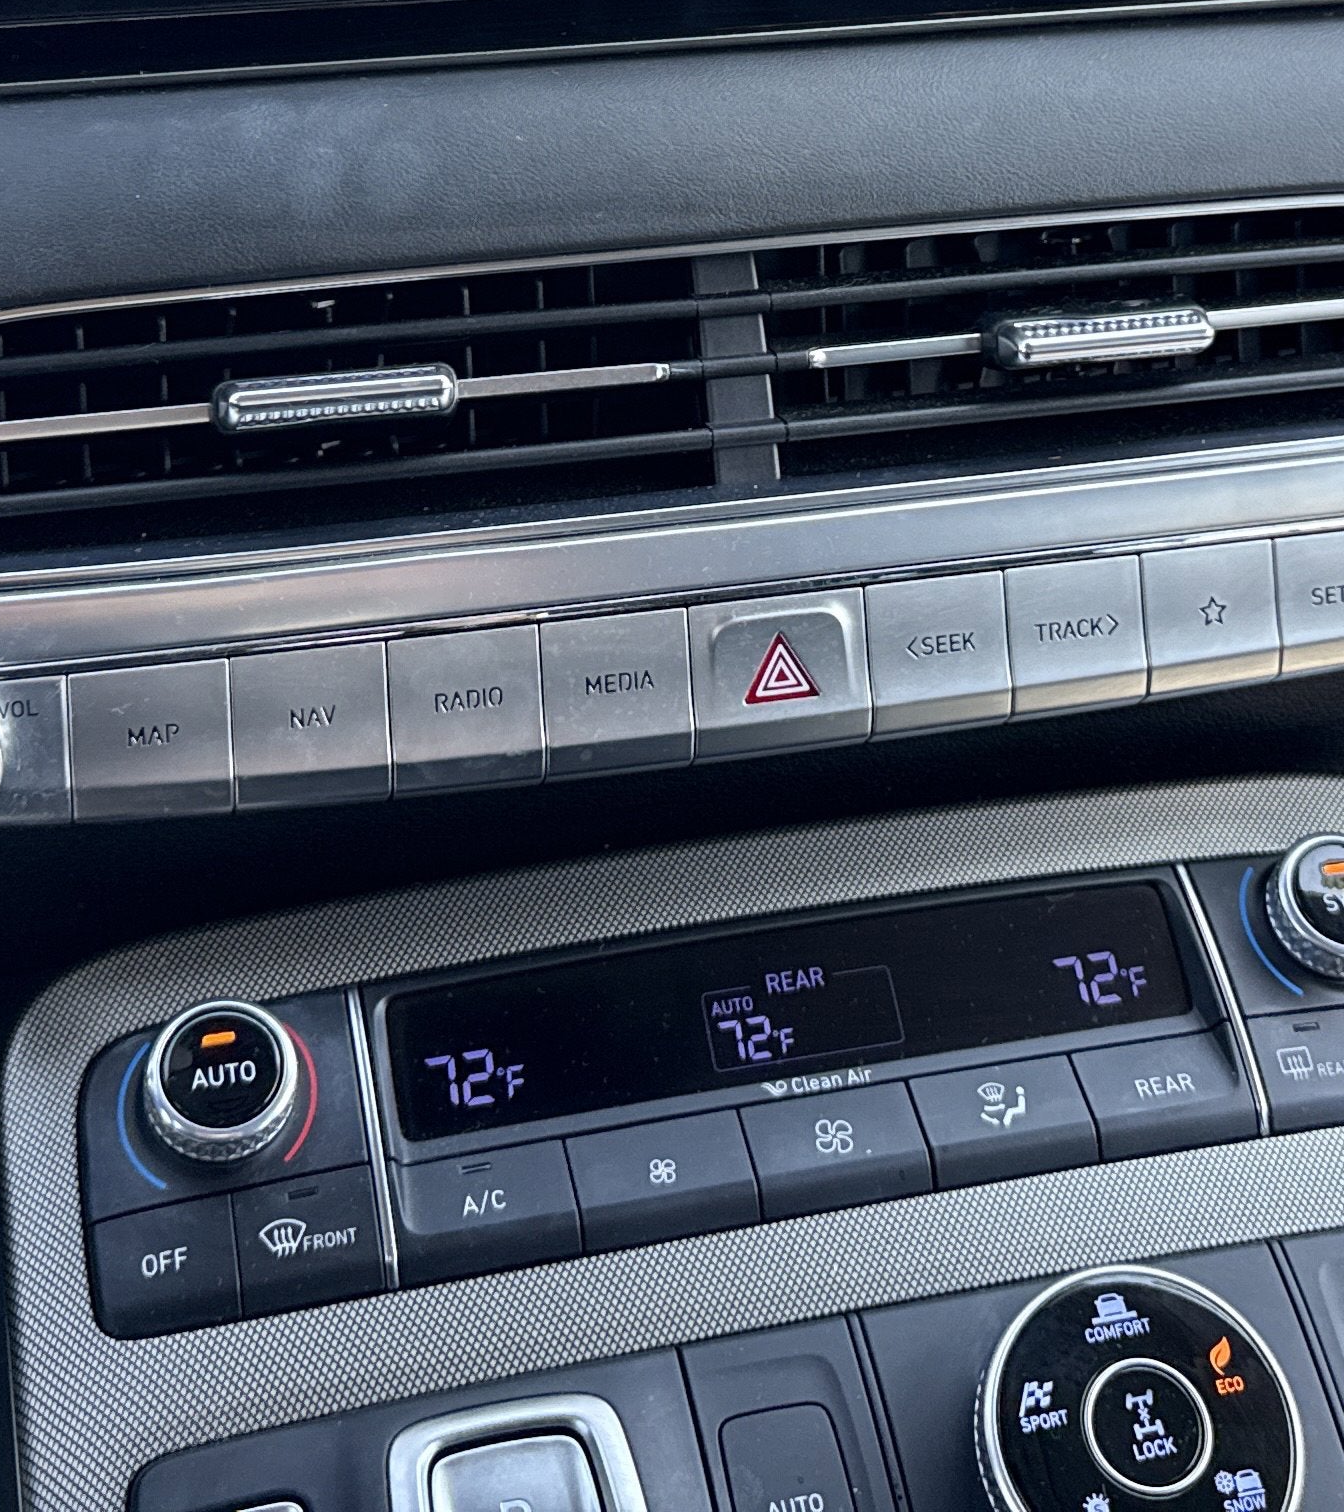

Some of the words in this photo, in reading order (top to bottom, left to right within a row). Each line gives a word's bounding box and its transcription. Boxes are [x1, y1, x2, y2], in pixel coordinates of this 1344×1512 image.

[585, 669, 655, 696] MEDIA
[434, 686, 503, 714] RADIO
[289, 704, 336, 730] NAV
[128, 724, 180, 747] MAP
[765, 967, 825, 993] REAR
[711, 996, 753, 1017] AUTO
[191, 1060, 257, 1091] AUTO
[791, 1073, 843, 1094] Clean
[846, 1067, 872, 1086] Air
[1134, 1073, 1195, 1099] REAR
[462, 1190, 507, 1217] A/C
[303, 1226, 357, 1251] FRONT
[141, 1246, 188, 1279] OFF
[1084, 1317, 1151, 1344] COMFORT
[1215, 1376, 1244, 1394] ECO
[1019, 1408, 1068, 1433] SPORT
[1132, 1436, 1178, 1462] LOCK
[768, 1492, 825, 1512] AUTO
[1223, 1494, 1267, 1512] SNOW
